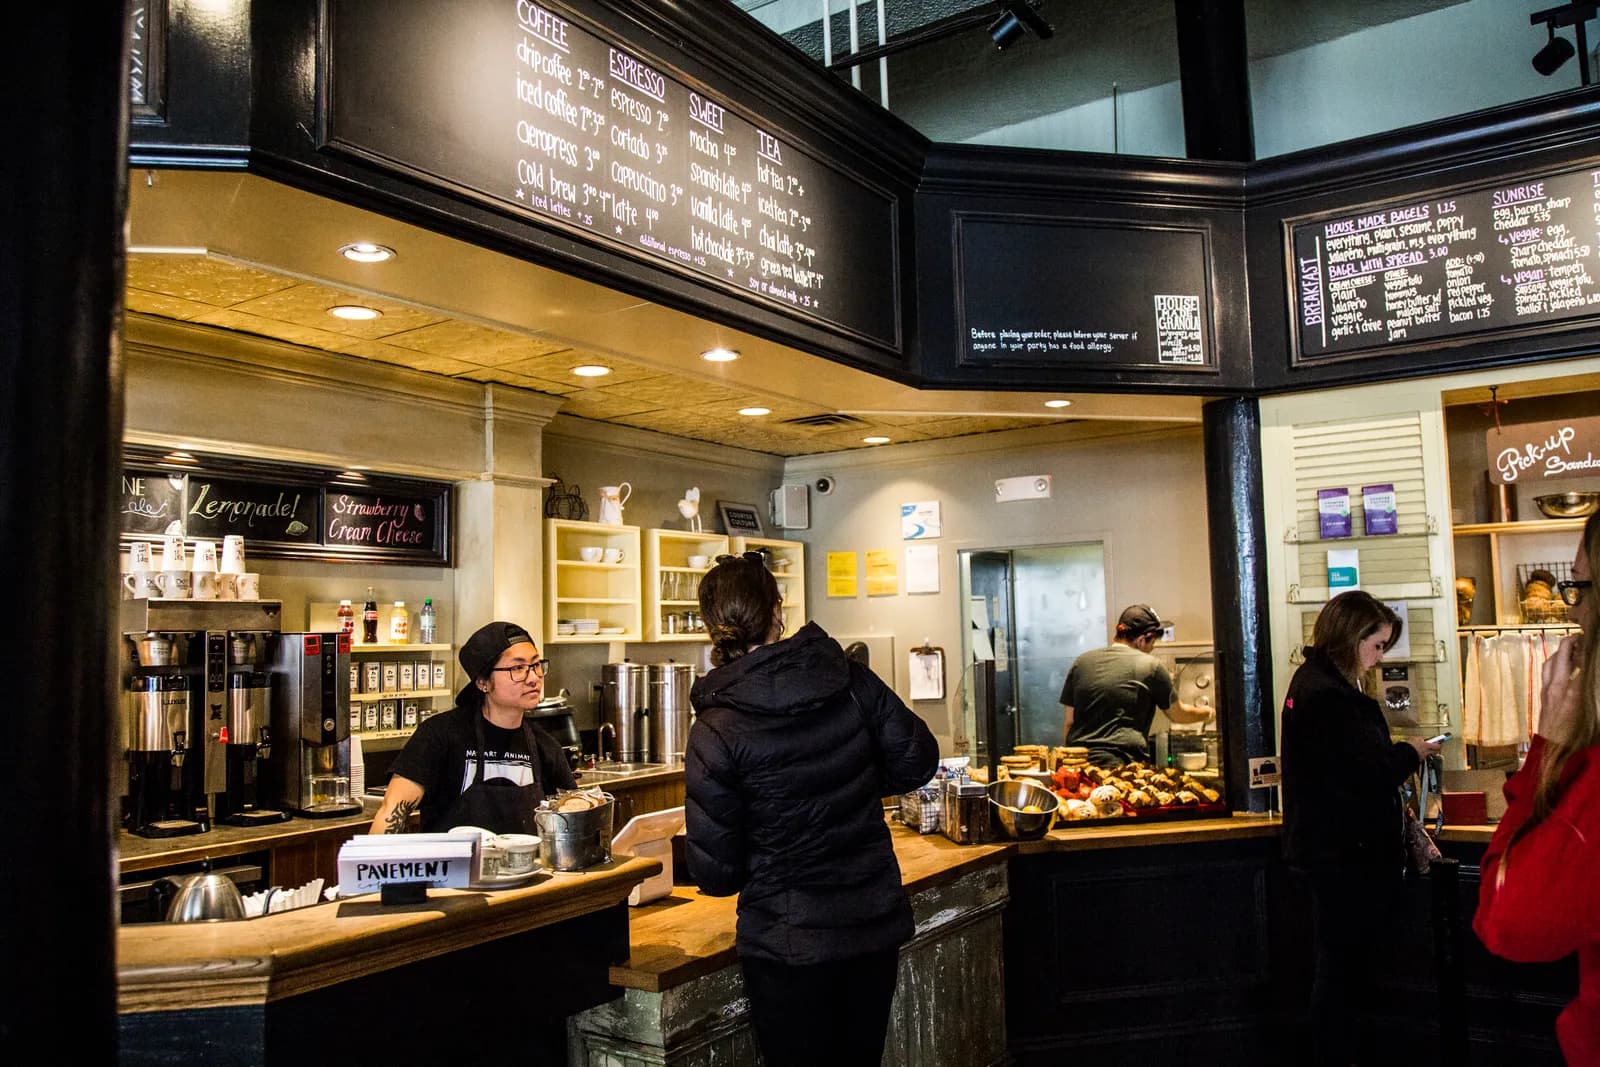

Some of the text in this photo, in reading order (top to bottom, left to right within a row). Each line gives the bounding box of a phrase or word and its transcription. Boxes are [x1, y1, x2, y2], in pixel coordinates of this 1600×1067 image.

[517, 0, 568, 46] COFFEE
[517, 37, 572, 85] drip coffee
[610, 48, 665, 97] ESPRESSO
[516, 72, 578, 126] iced coffee
[611, 88, 652, 125] espresso
[689, 92, 725, 129] SWEET
[690, 130, 718, 159] mocha
[757, 129, 780, 161] TEA
[758, 157, 784, 191] hot tea
[550, 168, 576, 203] brew
[723, 172, 739, 202] latte
[1493, 183, 1544, 205] SUNRISE
[532, 191, 571, 217] iced lattes
[612, 194, 637, 225] latte
[758, 192, 787, 225] iced tea
[1546, 197, 1571, 209] sharp
[691, 196, 738, 235] vanilla latte
[1325, 201, 1456, 237] HOUSE MADE BAGELS 1.25
[1437, 216, 1464, 232] poppy
[1494, 214, 1529, 230] cheddar
[692, 225, 734, 264] hot chocolate
[760, 224, 793, 259] chai latte
[1427, 228, 1476, 245] everything
[640, 234, 665, 253] additional
[668, 246, 691, 261] espresso
[1328, 246, 1448, 278] BAGEL WITH SPREAD 3.00
[1543, 250, 1574, 265] spinach
[761, 257, 780, 276] green
[782, 264, 792, 279] tea
[1446, 266, 1473, 279] tomato
[1549, 262, 1584, 278] tempeh
[769, 282, 786, 298] almond
[1329, 278, 1351, 292] CREAM
[1384, 278, 1405, 292] veggie
[1446, 276, 1471, 288] onion
[1447, 282, 1486, 298] red pepper
[1550, 277, 1575, 291] veggie
[1301, 258, 1322, 326] BREAKFAST
[1331, 289, 1356, 304] plain
[1549, 286, 1582, 300] pickled
[1158, 298, 1197, 310] HOUSE
[1385, 299, 1408, 312] honey
[1409, 293, 1430, 307] butter
[1425, 302, 1439, 315] salt
[1448, 295, 1476, 311] pickled
[1517, 303, 1542, 315] shallot
[1159, 316, 1199, 330] GRANOLA
[1162, 309, 1192, 318] MADE
[1331, 312, 1363, 327] veggie
[1386, 312, 1441, 330] peanut butter
[1449, 310, 1473, 323] bacon
[971, 328, 996, 339] Before
[1000, 330, 1020, 341] placing
[1021, 331, 1033, 341] your
[1034, 329, 1052, 339] order,
[1053, 330, 1072, 340] please
[1073, 330, 1092, 338] inform
[1093, 332, 1108, 341] your
[1132, 331, 1138, 340] if
[1332, 323, 1354, 340] garlic
[1362, 320, 1382, 332] chive
[1388, 327, 1407, 341] jam
[973, 342, 996, 352] anyone
[1010, 343, 1023, 351] your
[1027, 342, 1047, 352] party
[1069, 342, 1084, 350] food
[1087, 342, 1114, 353] allergy.
[189, 484, 301, 527] Lemonade!
[332, 494, 409, 527] Strawberry
[329, 518, 423, 544] Cream Cheese
[357, 860, 452, 880] PAVEMENT
